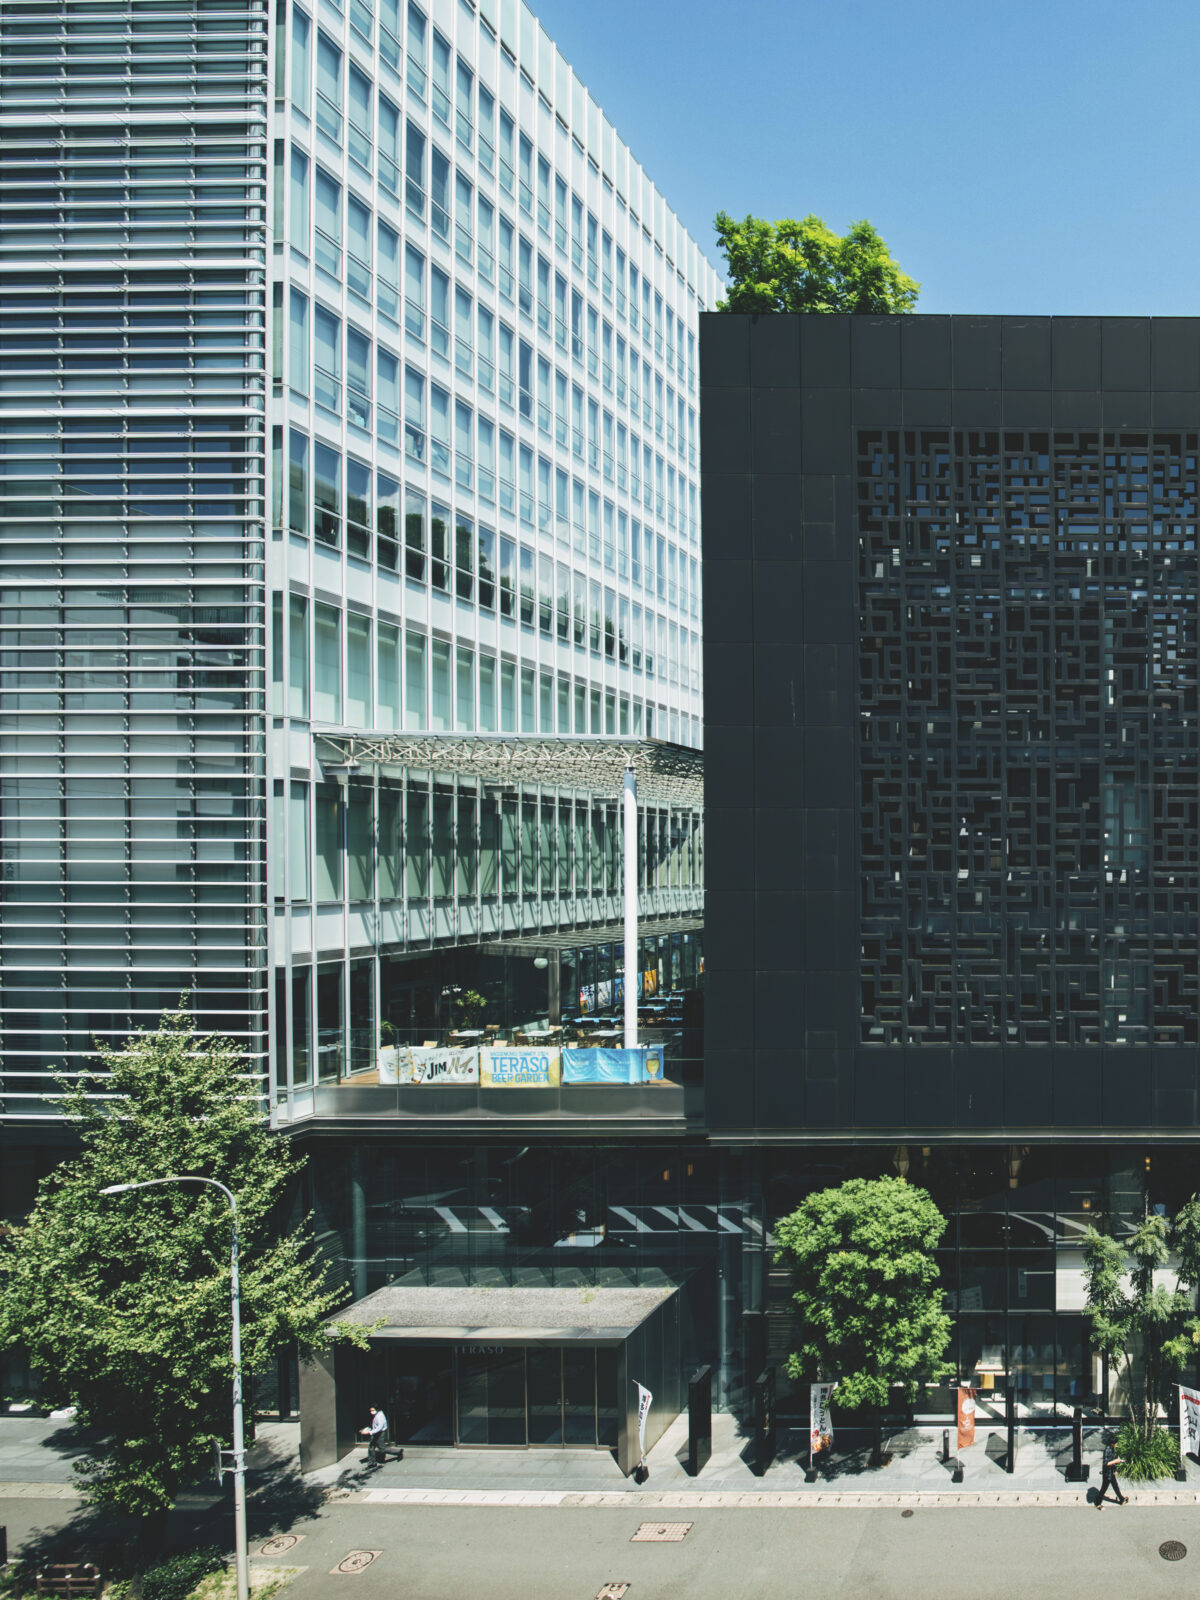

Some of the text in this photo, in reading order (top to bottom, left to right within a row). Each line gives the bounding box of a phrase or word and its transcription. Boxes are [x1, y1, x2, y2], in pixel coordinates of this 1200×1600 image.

[490, 1057, 549, 1073] TERASO
[491, 1073, 550, 1083] BEER GARDEN
